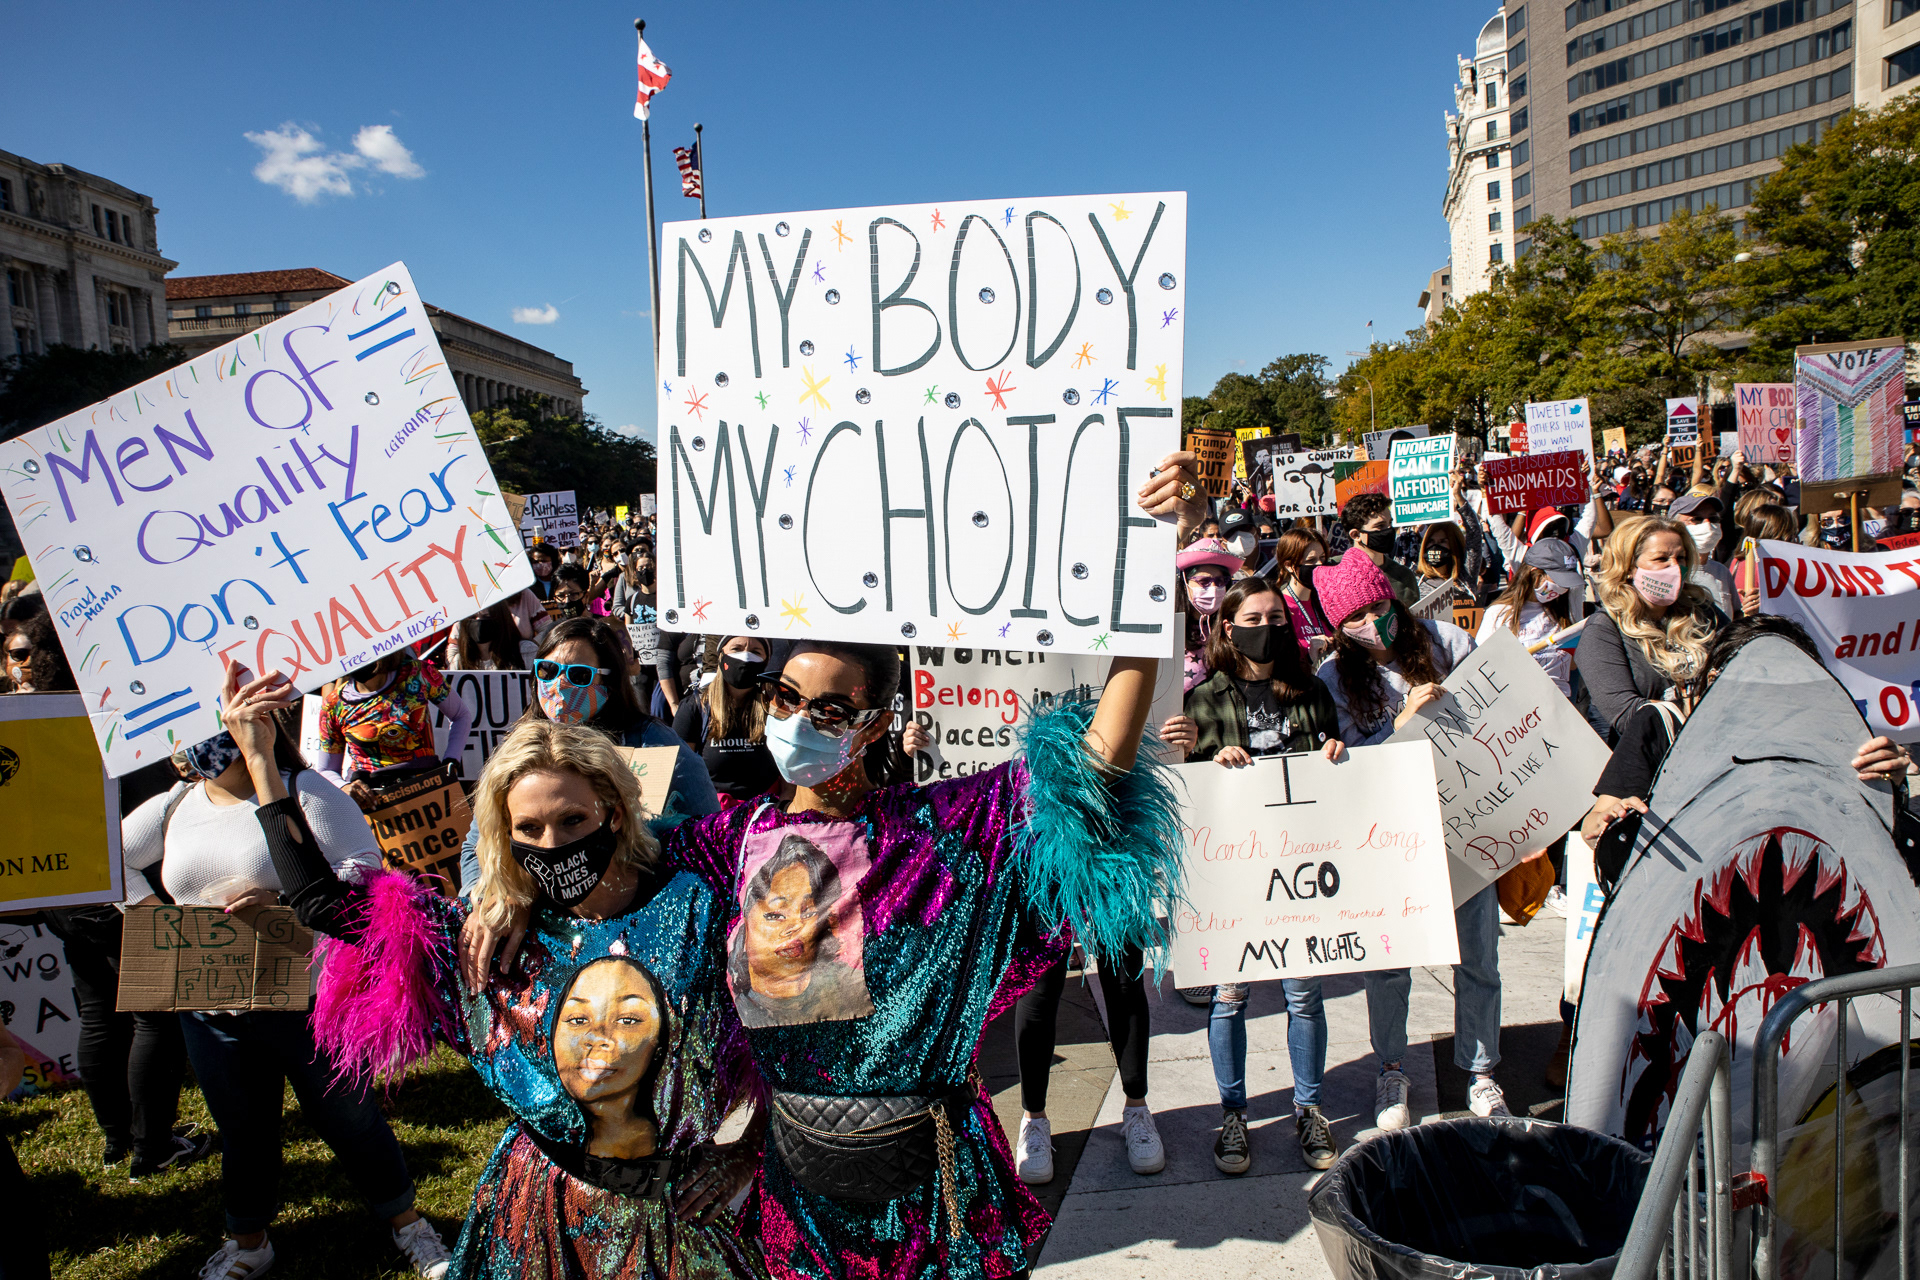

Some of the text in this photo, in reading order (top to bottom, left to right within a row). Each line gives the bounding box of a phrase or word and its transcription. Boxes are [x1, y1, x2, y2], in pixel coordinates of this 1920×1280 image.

[678, 201, 1166, 378] MY BODY
[1827, 348, 1882, 370] VOTE
[1741, 387, 1794, 407] MY BOD
[1528, 402, 1568, 419] TWEET
[1741, 408, 1763, 426] MY
[1365, 432, 1382, 443] RIP
[1530, 420, 1585, 434] OTHERS HOW
[1674, 434, 1693, 442] ACA
[1743, 427, 1765, 444] MY
[1192, 436, 1232, 450] Trump/
[1194, 447, 1227, 460] Pence
[1396, 438, 1450, 456] WOMEN
[1531, 435, 1573, 449] YOU WANT
[1744, 445, 1765, 462] MY
[1275, 455, 1295, 467] NO
[1308, 450, 1353, 462] COUNTRY
[1393, 454, 1449, 478] CAN'T
[1484, 462, 1507, 476] THIS
[1510, 453, 1557, 472] EPISODE
[1559, 451, 1571, 464] OF
[1344, 466, 1377, 482] WELL
[1488, 468, 1577, 495] HANDMAIDS
[137, 425, 359, 564] Quality
[1200, 478, 1229, 495] OW!
[1394, 476, 1449, 498] AFFORD
[327, 454, 468, 560] Fear
[530, 494, 576, 517] Ruthless
[1279, 504, 1300, 514] FOR
[1306, 505, 1324, 513] OLD
[1396, 499, 1449, 516] TRUMPCARE
[1494, 493, 1527, 511] TALE
[1536, 487, 1580, 507] SUCKS
[670, 406, 1174, 633] MY CHOICE
[1642, 575, 1659, 585] UNITE
[1646, 583, 1670, 594] BETTER
[1763, 557, 1885, 598] DUMP
[116, 531, 310, 666] Don't
[1642, 587, 1665, 598] FUTURE
[60, 585, 97, 628] Proud
[218, 525, 474, 692] EQUALITY
[340, 651, 373, 672] Free
[373, 633, 405, 654] MOM
[1835, 622, 1906, 660] and
[915, 670, 1019, 724] Belong
[1423, 660, 1509, 757] FRAGILE
[916, 711, 1011, 747] Places
[1456, 760, 1480, 788] A
[1510, 752, 1544, 786] LIKE
[1542, 738, 1559, 758] A
[1258, 753, 1317, 807] I
[1182, 822, 1426, 862] March because long
[31, 853, 70, 873] ME
[553, 850, 588, 875] BLACK
[557, 866, 589, 887] LIVES
[561, 872, 598, 900] MATTER
[1266, 861, 1341, 901] AGO
[1265, 911, 1321, 925] women
[1402, 897, 1429, 917] for
[202, 953, 251, 965] IS THE
[1238, 932, 1366, 972] MY RIGHTS
[176, 957, 292, 1007] FLY!
